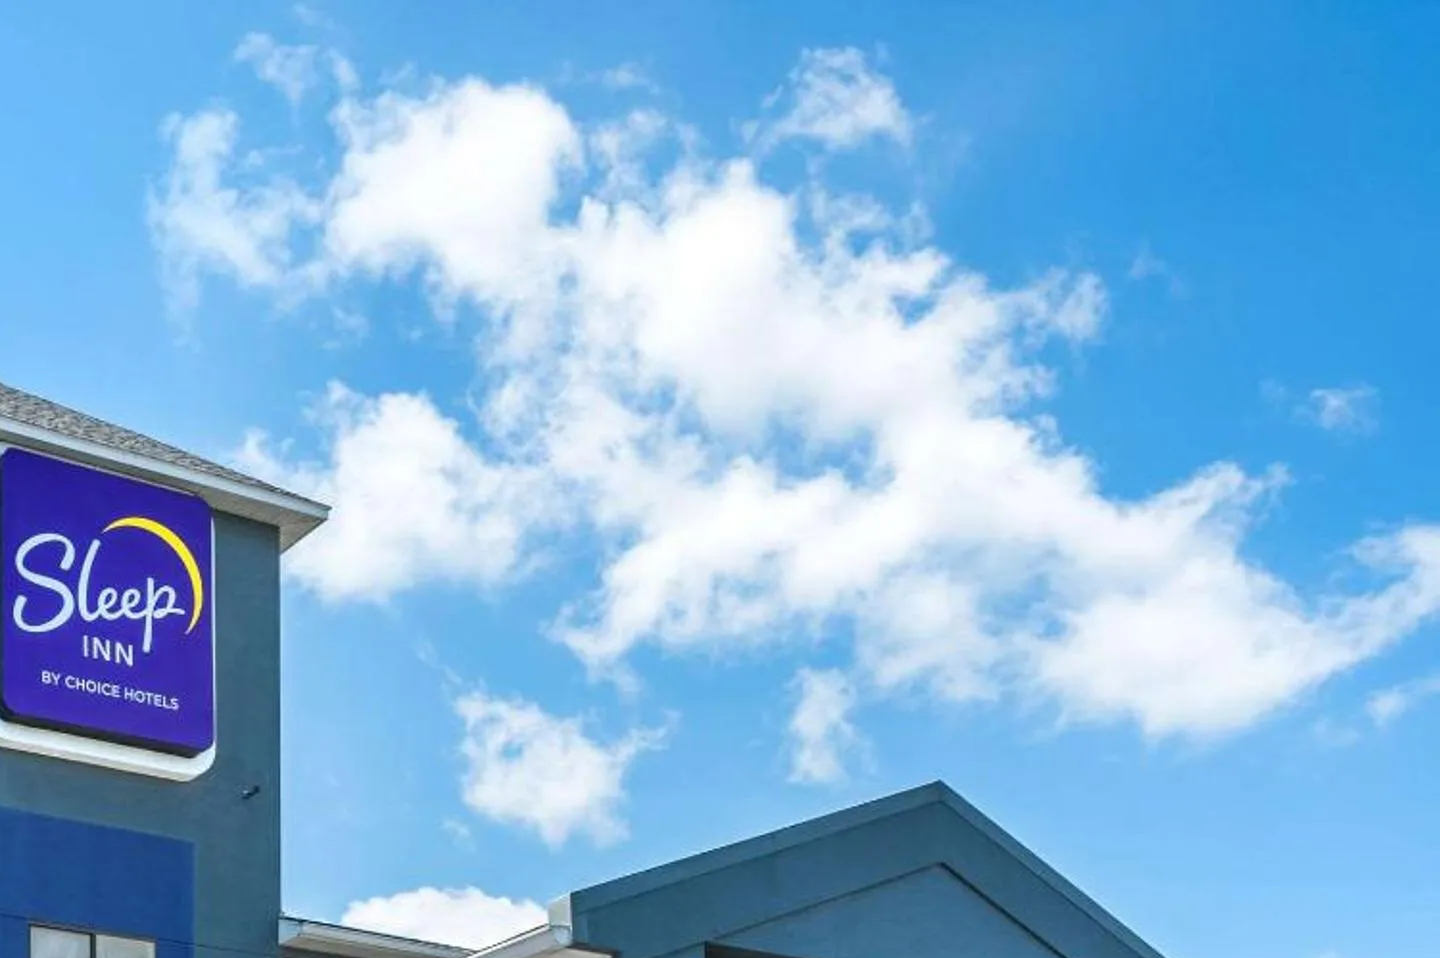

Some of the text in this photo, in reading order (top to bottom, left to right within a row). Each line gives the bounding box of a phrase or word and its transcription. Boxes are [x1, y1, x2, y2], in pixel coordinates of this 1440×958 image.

[13, 532, 186, 653] Sleep
[82, 634, 134, 667] INN
[41, 669, 180, 710] BY CHOICE HOTELS
